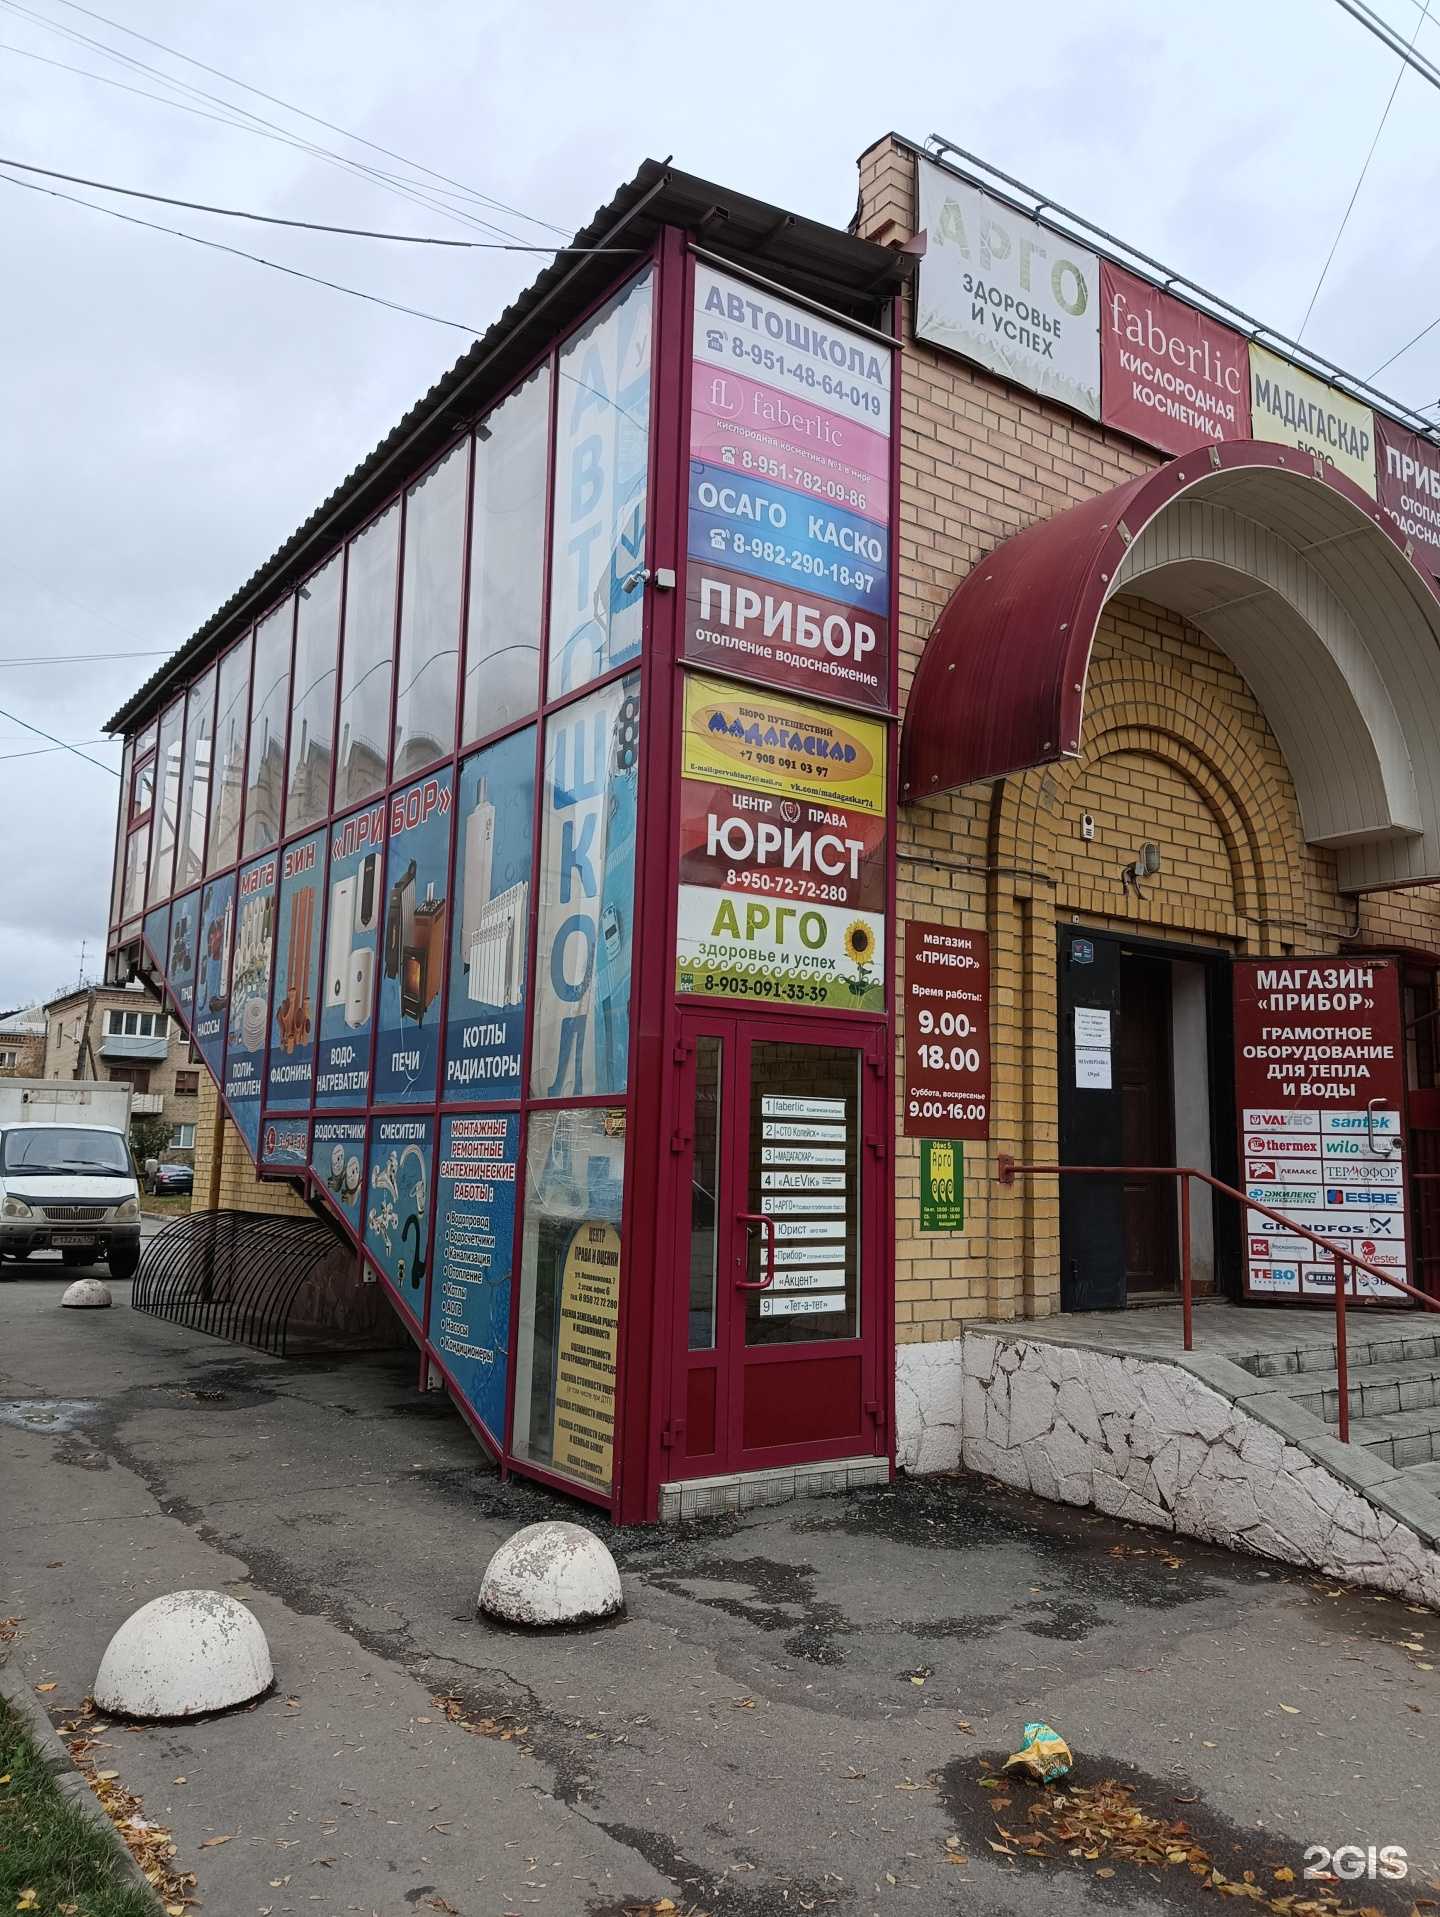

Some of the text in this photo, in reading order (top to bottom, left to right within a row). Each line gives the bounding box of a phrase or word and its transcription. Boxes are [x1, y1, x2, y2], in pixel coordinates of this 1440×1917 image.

[933, 196, 1088, 317] АРГО
[962, 273, 1061, 339] ЗДОРОВЬЕ
[971, 303, 985, 326] И
[705, 286, 883, 384] АВТОШКОЛА
[991, 312, 1053, 360] УСПЕХ
[1111, 293, 1241, 395] faberlic
[732, 336, 881, 416] 8-951-48-64-019
[1119, 349, 1235, 422] КИСЛОРОДНАЯ
[752, 391, 843, 447] faberlic
[1132, 382, 1225, 441] КОСМЕТИКА
[1255, 373, 1369, 462] МАДАГАСКАР
[716, 420, 778, 446] кислородная
[780, 442, 826, 465] косметика
[742, 450, 867, 510] 8-951-782-09-86
[698, 482, 883, 563] ОСАГО КАСКО
[733, 533, 874, 593] 8-982-290-18-97
[700, 578, 876, 662] ПРИБОР
[696, 629, 878, 687] отопление водоснабжение
[739, 707, 833, 737] БЮРО ПУТЕШЕСТВИЙ
[707, 711, 857, 763] МАДАГАСКАР
[740, 751, 828, 777] +7 908 091 03 97
[732, 793, 847, 828] ЦЕНТР ПРАВА
[332, 779, 453, 862] «ПРИБОР»
[706, 813, 864, 880] ЮРИСТ
[726, 869, 847, 902] 8-950-72-72-280
[711, 898, 828, 950] АРГО
[923, 933, 972, 950] магазин
[699, 942, 836, 970] здоровье и успех
[915, 951, 980, 970] «ПРИБОР»
[1257, 969, 1374, 989] МАГАЗИН
[705, 975, 828, 1003] 8-903-091-33-39
[912, 984, 982, 1002] Время работы:
[1257, 993, 1375, 1011] «ПРИБОР»
[918, 1009, 977, 1037] 9.00-
[463, 1023, 506, 1048] КОТЛЫ
[1262, 1027, 1373, 1040] ГРАМОТНОЕ
[330, 1046, 356, 1067] ВОДО-
[391, 1050, 420, 1072] ПЕЧИ
[917, 1044, 980, 1072] 18.00
[1243, 1045, 1394, 1061] ОБОРУДОВАНИЕ
[232, 1061, 255, 1078] ПОЛИ-
[270, 1064, 312, 1083] ФАСОНИНА
[447, 1054, 520, 1084] РАДИАТОРЫ
[1267, 1064, 1371, 1079] ДЛЯ ТЕПЛА
[226, 1080, 261, 1098] ПРОПИЛЕН
[317, 1071, 369, 1092] НАГРЕВАТЕЛИ
[1283, 1083, 1356, 1098] И ВОДЫ
[910, 1087, 985, 1100] Суббота, воскресенье
[765, 1101, 771, 1112] 1
[775, 1101, 804, 1112] faberlic
[909, 1101, 985, 1121] 9.00-16.00
[380, 1123, 425, 1139] СМЕСИТЕЛИ
[451, 1120, 507, 1137] МОНТАЖНЫЕ
[766, 1125, 772, 1136] 2
[1262, 1114, 1392, 1129] VALTEC santek
[314, 1124, 366, 1141] ВОДОСЧЕТЧИКИ
[451, 1142, 503, 1159] РЕМОНТНЫЕ
[765, 1149, 772, 1161] 3
[1266, 1139, 1318, 1152] thermex
[1326, 1140, 1360, 1153] wilo
[932, 1151, 952, 1171] Арго
[440, 1162, 515, 1180] САНТЕХНИЧЕСКИЕ
[764, 1175, 771, 1186] 4
[1280, 1165, 1398, 1178] ЛЕМАКС ТЕРМОФОР
[1264, 1190, 1318, 1199] ДЖИЛЕКС
[1345, 1192, 1398, 1204] ESBE
[764, 1199, 772, 1211] 5
[450, 1211, 489, 1230] Водопровод
[778, 1223, 807, 1236] Юрист
[1262, 1222, 1364, 1234] GRNDFOS
[449, 1230, 495, 1247] Водосчетчики
[589, 1226, 606, 1243] ЦЕНТР
[448, 1248, 491, 1266] Канализация
[1363, 1253, 1399, 1264] Wester
[447, 1266, 483, 1283] Отопление
[779, 1274, 818, 1287] «Акцент»
[1251, 1268, 1296, 1281] TEBO
[446, 1284, 467, 1299] Котлы
[763, 1300, 828, 1312] 9 «Тет-а-тет»
[445, 1321, 468, 1337] Насосы
[443, 1338, 493, 1364] Кондиционеры
